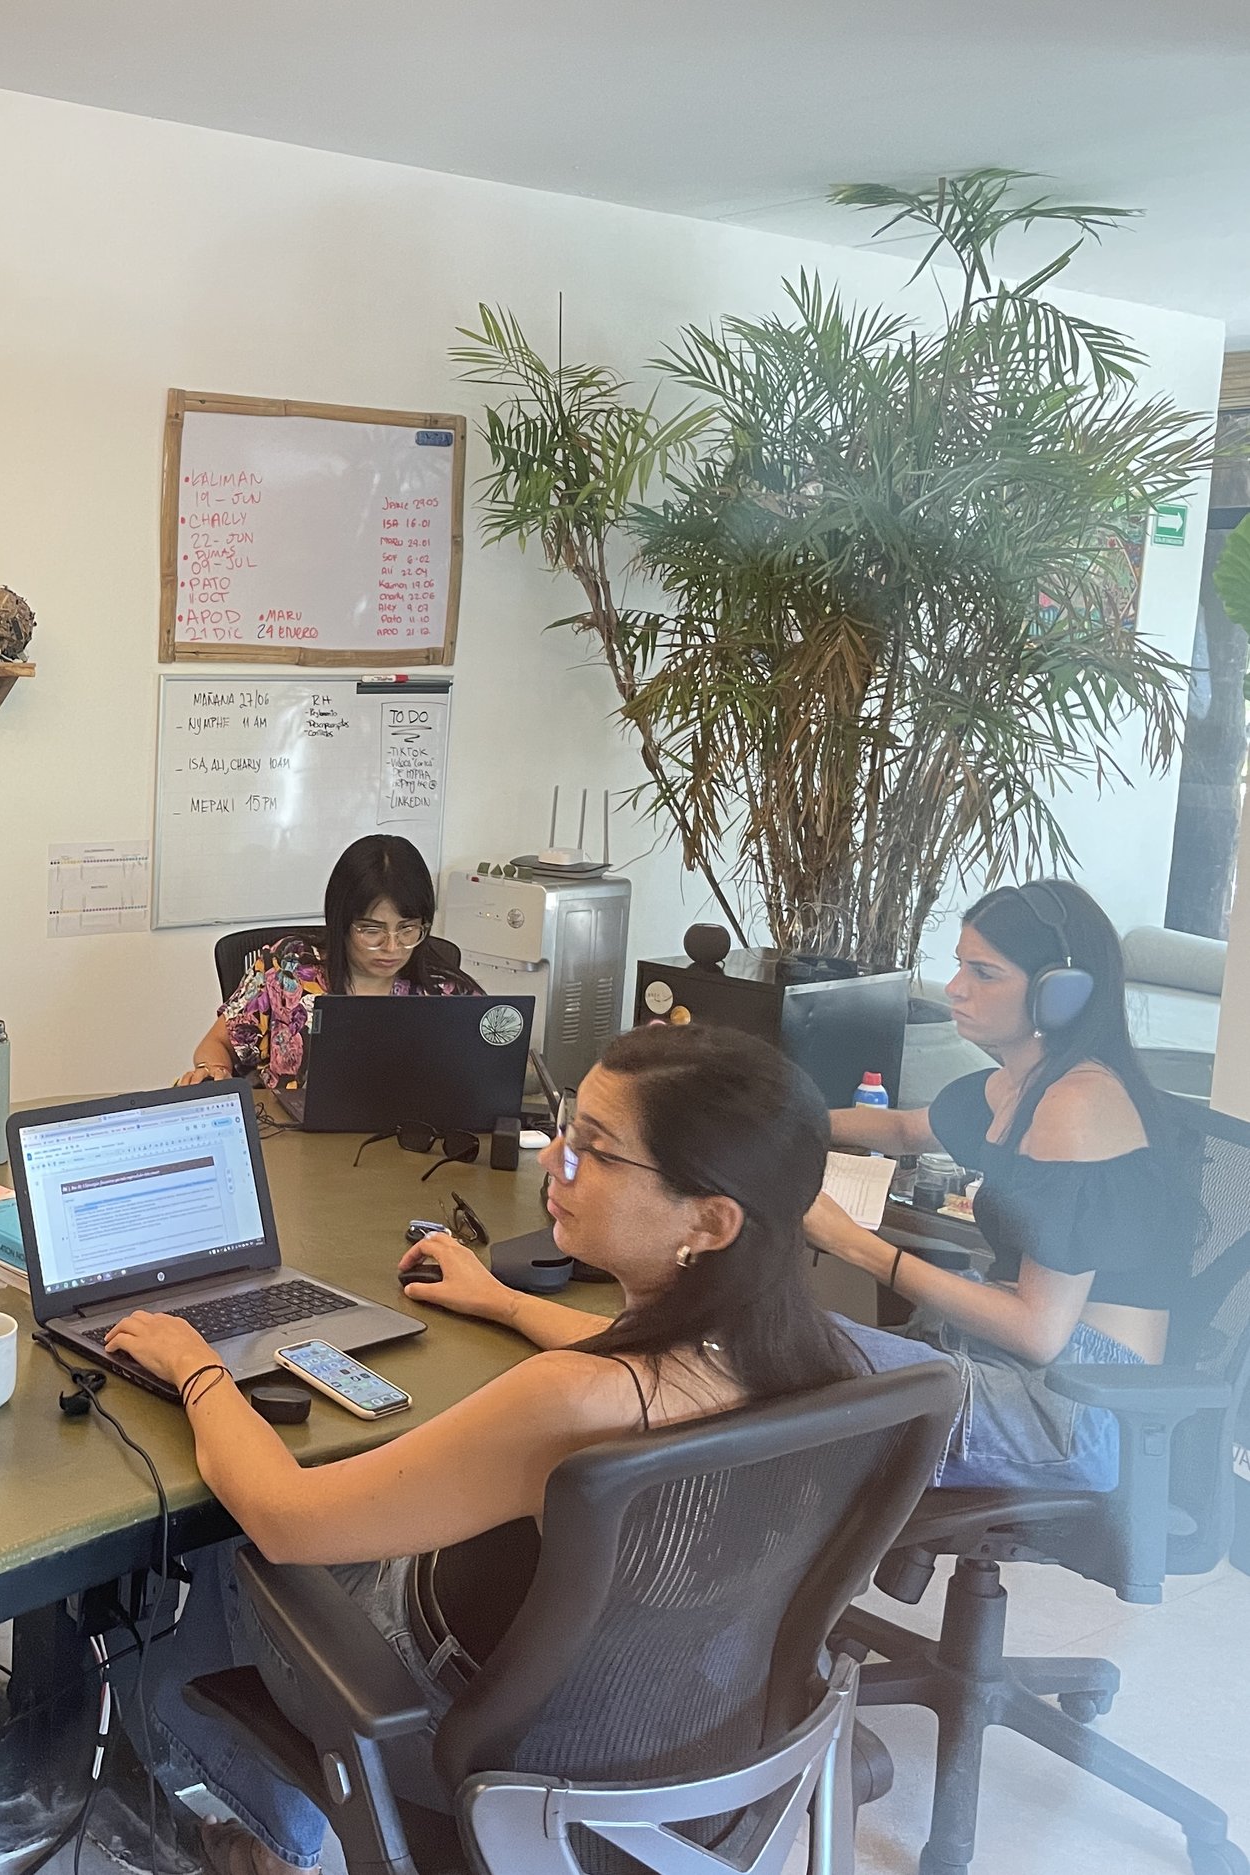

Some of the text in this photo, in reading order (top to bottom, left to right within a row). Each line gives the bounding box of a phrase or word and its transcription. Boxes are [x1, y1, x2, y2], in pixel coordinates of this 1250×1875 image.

[191, 469, 263, 487] KALIMAN
[195, 491, 210, 507] 19
[232, 491, 262, 505] JUN
[189, 511, 247, 529] CHARLY
[226, 532, 254, 544] JUN
[189, 577, 231, 591] PATO
[186, 608, 303, 626] APOD MARU
[193, 689, 270, 709] MAÑANA 27/06
[389, 709, 429, 724] TO DO
[230, 757, 262, 774] CHARLY
